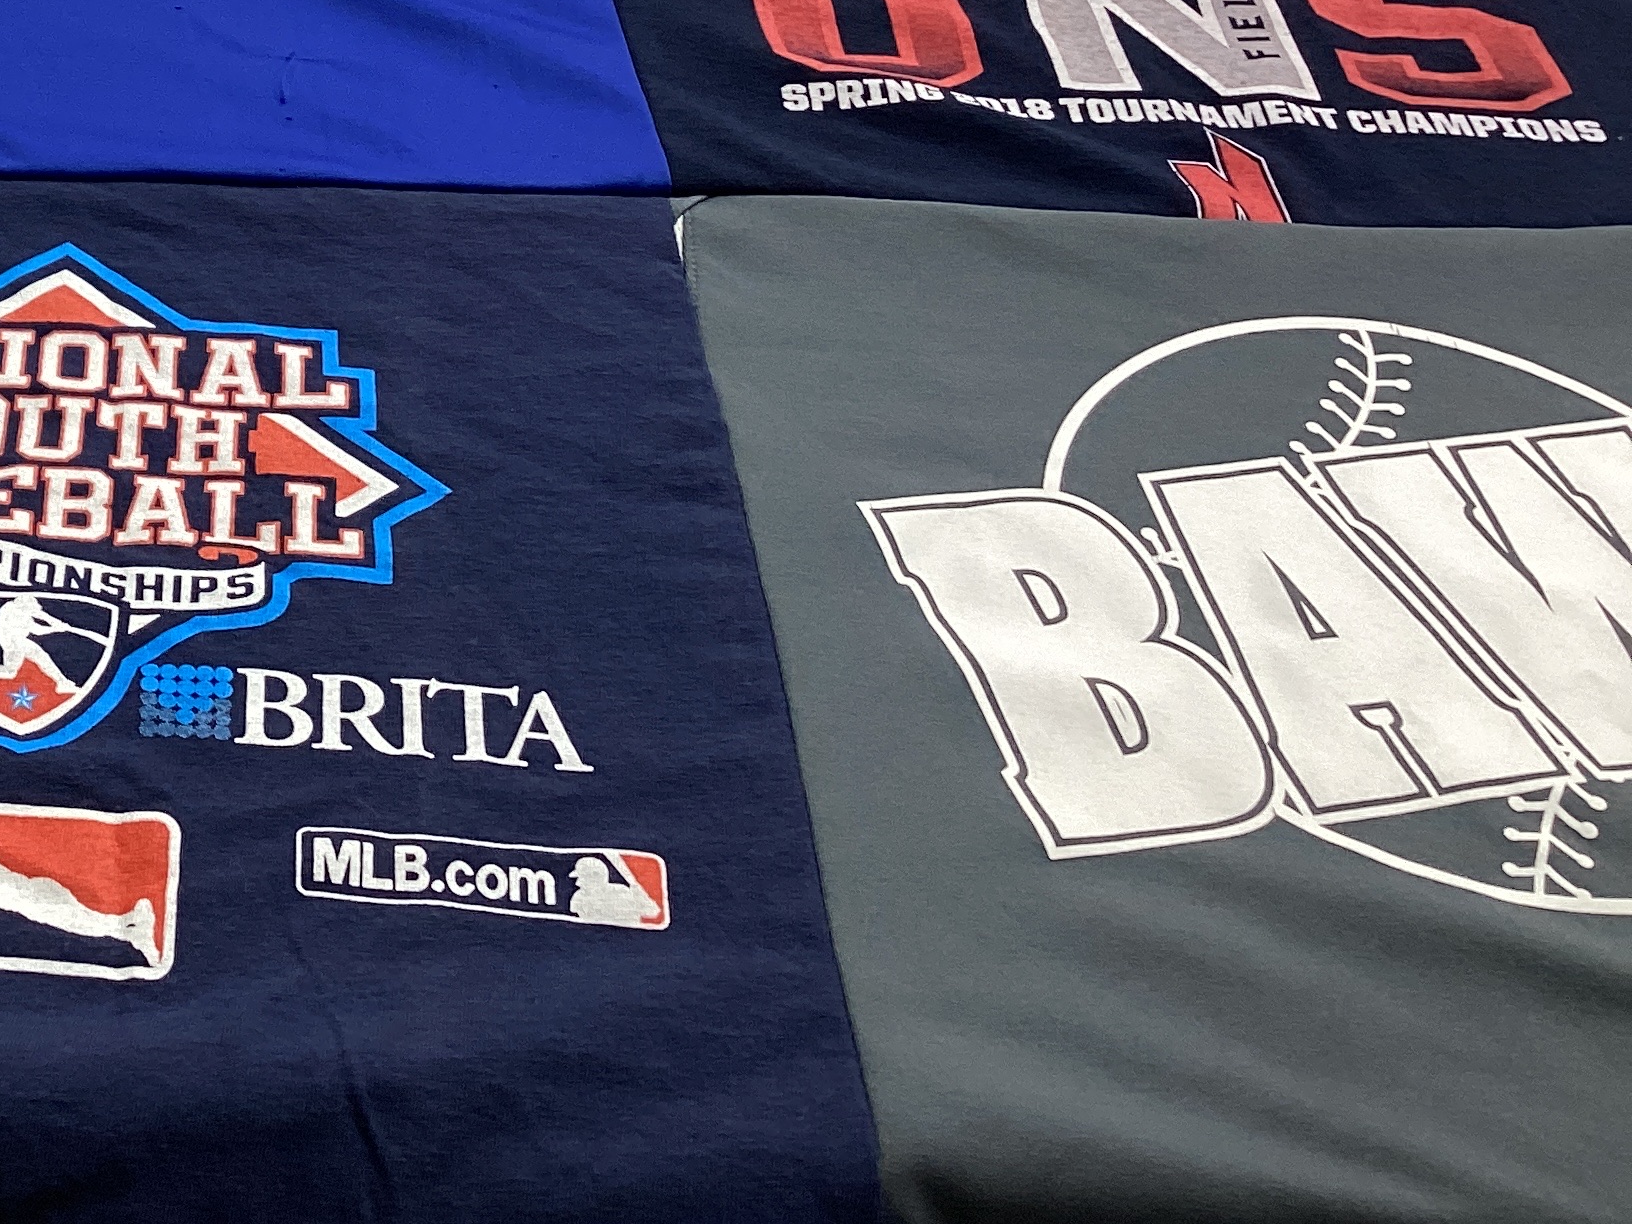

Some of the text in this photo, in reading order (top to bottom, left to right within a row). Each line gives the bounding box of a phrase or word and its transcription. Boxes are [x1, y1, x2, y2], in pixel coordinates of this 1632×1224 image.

[780, 78, 1609, 144] SPRING 2018 TOURNAMENT CHAMPIONS
[232, 666, 595, 773] BRITA
[311, 837, 557, 907] MLB.com
